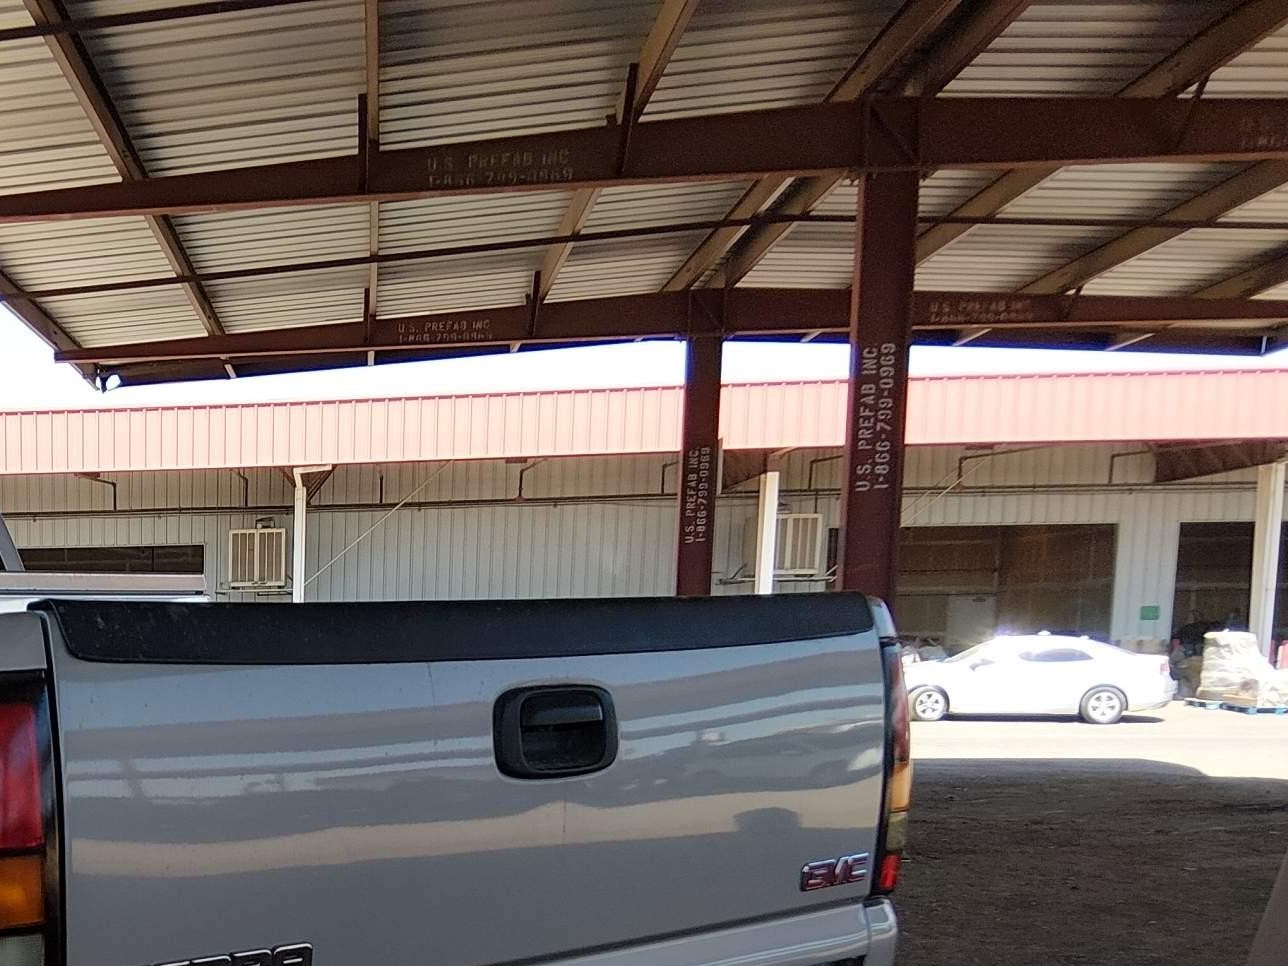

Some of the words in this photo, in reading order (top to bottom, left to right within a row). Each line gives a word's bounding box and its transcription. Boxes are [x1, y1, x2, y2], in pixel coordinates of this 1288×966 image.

[424, 320, 467, 332] PREFAB
[857, 383, 876, 450] PREFAB
[873, 343, 896, 489] 1-866-799-0969
[685, 473, 698, 517] PREFAB
[855, 459, 873, 492] U.S.
[684, 521, 695, 544] U.S.
[799, 851, 869, 892] GMC
